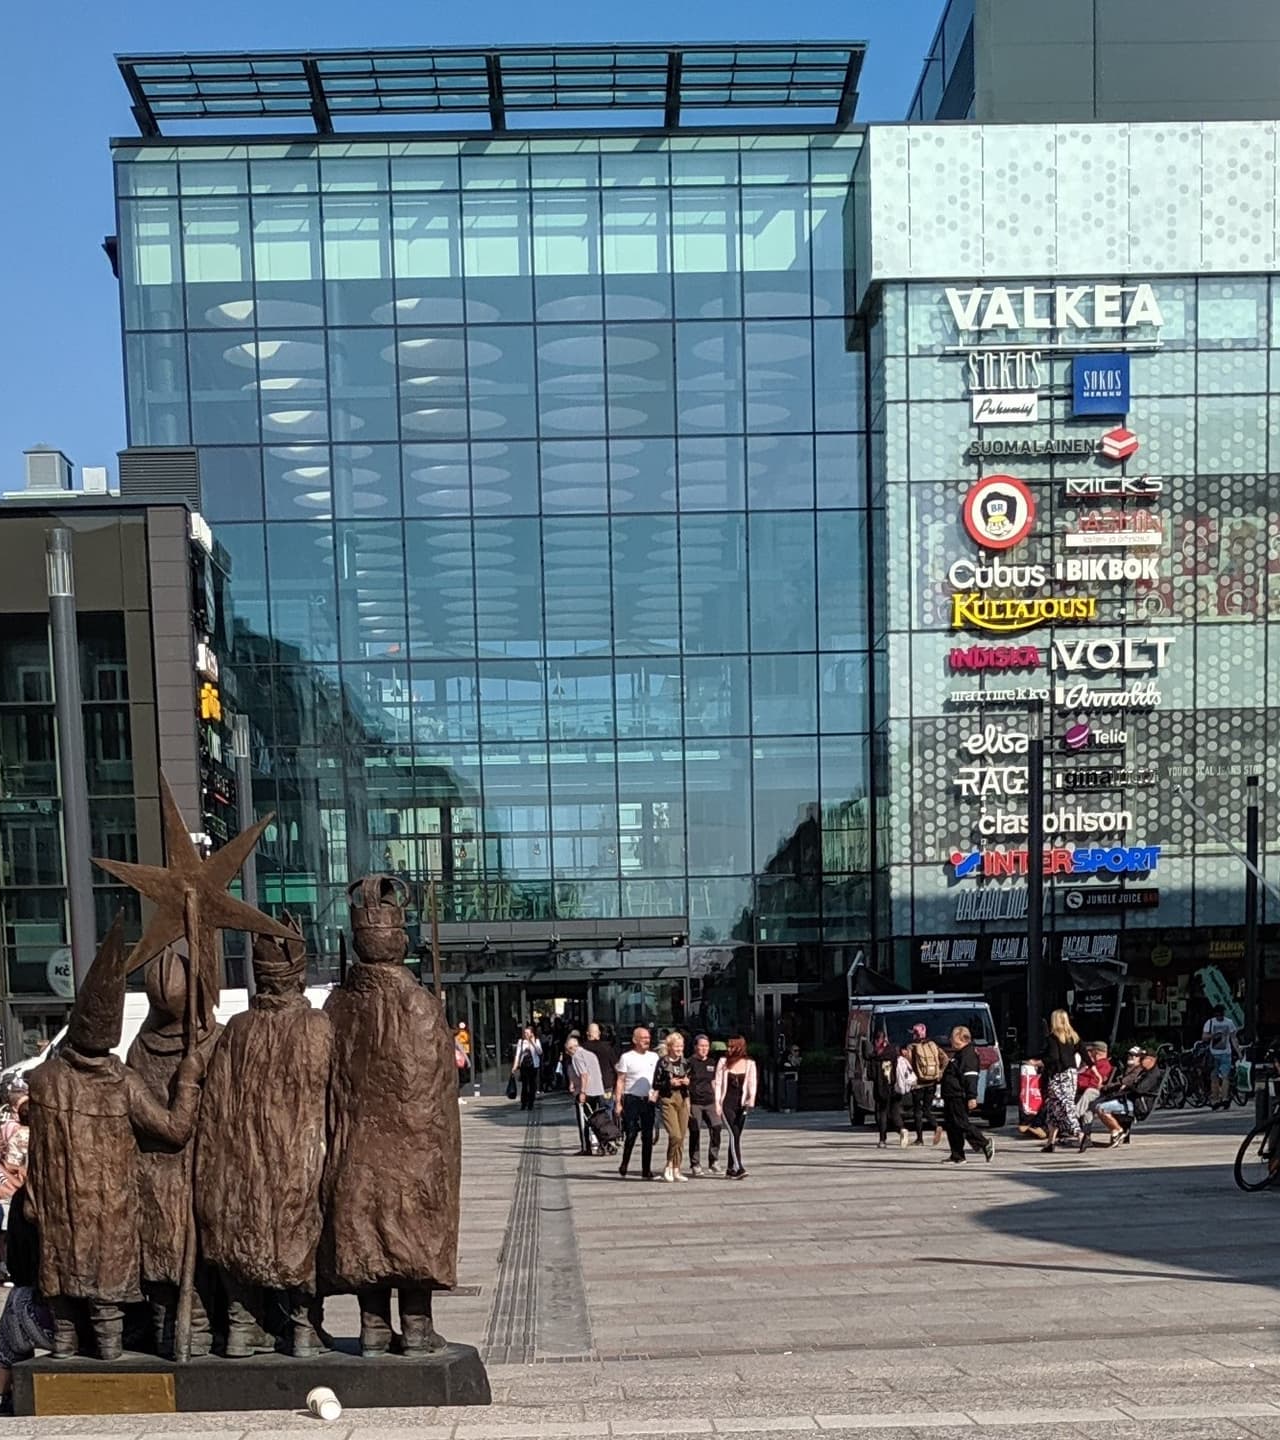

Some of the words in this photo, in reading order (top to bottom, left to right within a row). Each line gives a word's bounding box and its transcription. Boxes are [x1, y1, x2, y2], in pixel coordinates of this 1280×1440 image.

[945, 284, 1164, 329] VALKEA
[969, 351, 1041, 390] SOKOS
[1083, 370, 1122, 390] SOKOS
[970, 439, 1095, 456] SUOMALAINEN
[990, 503, 1004, 513] BR
[949, 557, 1046, 588] Cubus
[952, 593, 1097, 630] KULTAJOUSI
[950, 645, 1040, 669] INDISKA
[1053, 637, 1176, 670] VOLT
[951, 688, 1050, 702] marimekko
[1066, 683, 1161, 708] Arnolds
[963, 723, 1028, 754] elisa
[1093, 729, 1128, 744] Telia
[954, 767, 1029, 796] RAG
[1043, 806, 1133, 832] ohlson
[1086, 894, 1116, 904] JUNGLE
[1119, 893, 1141, 904] JUICE
